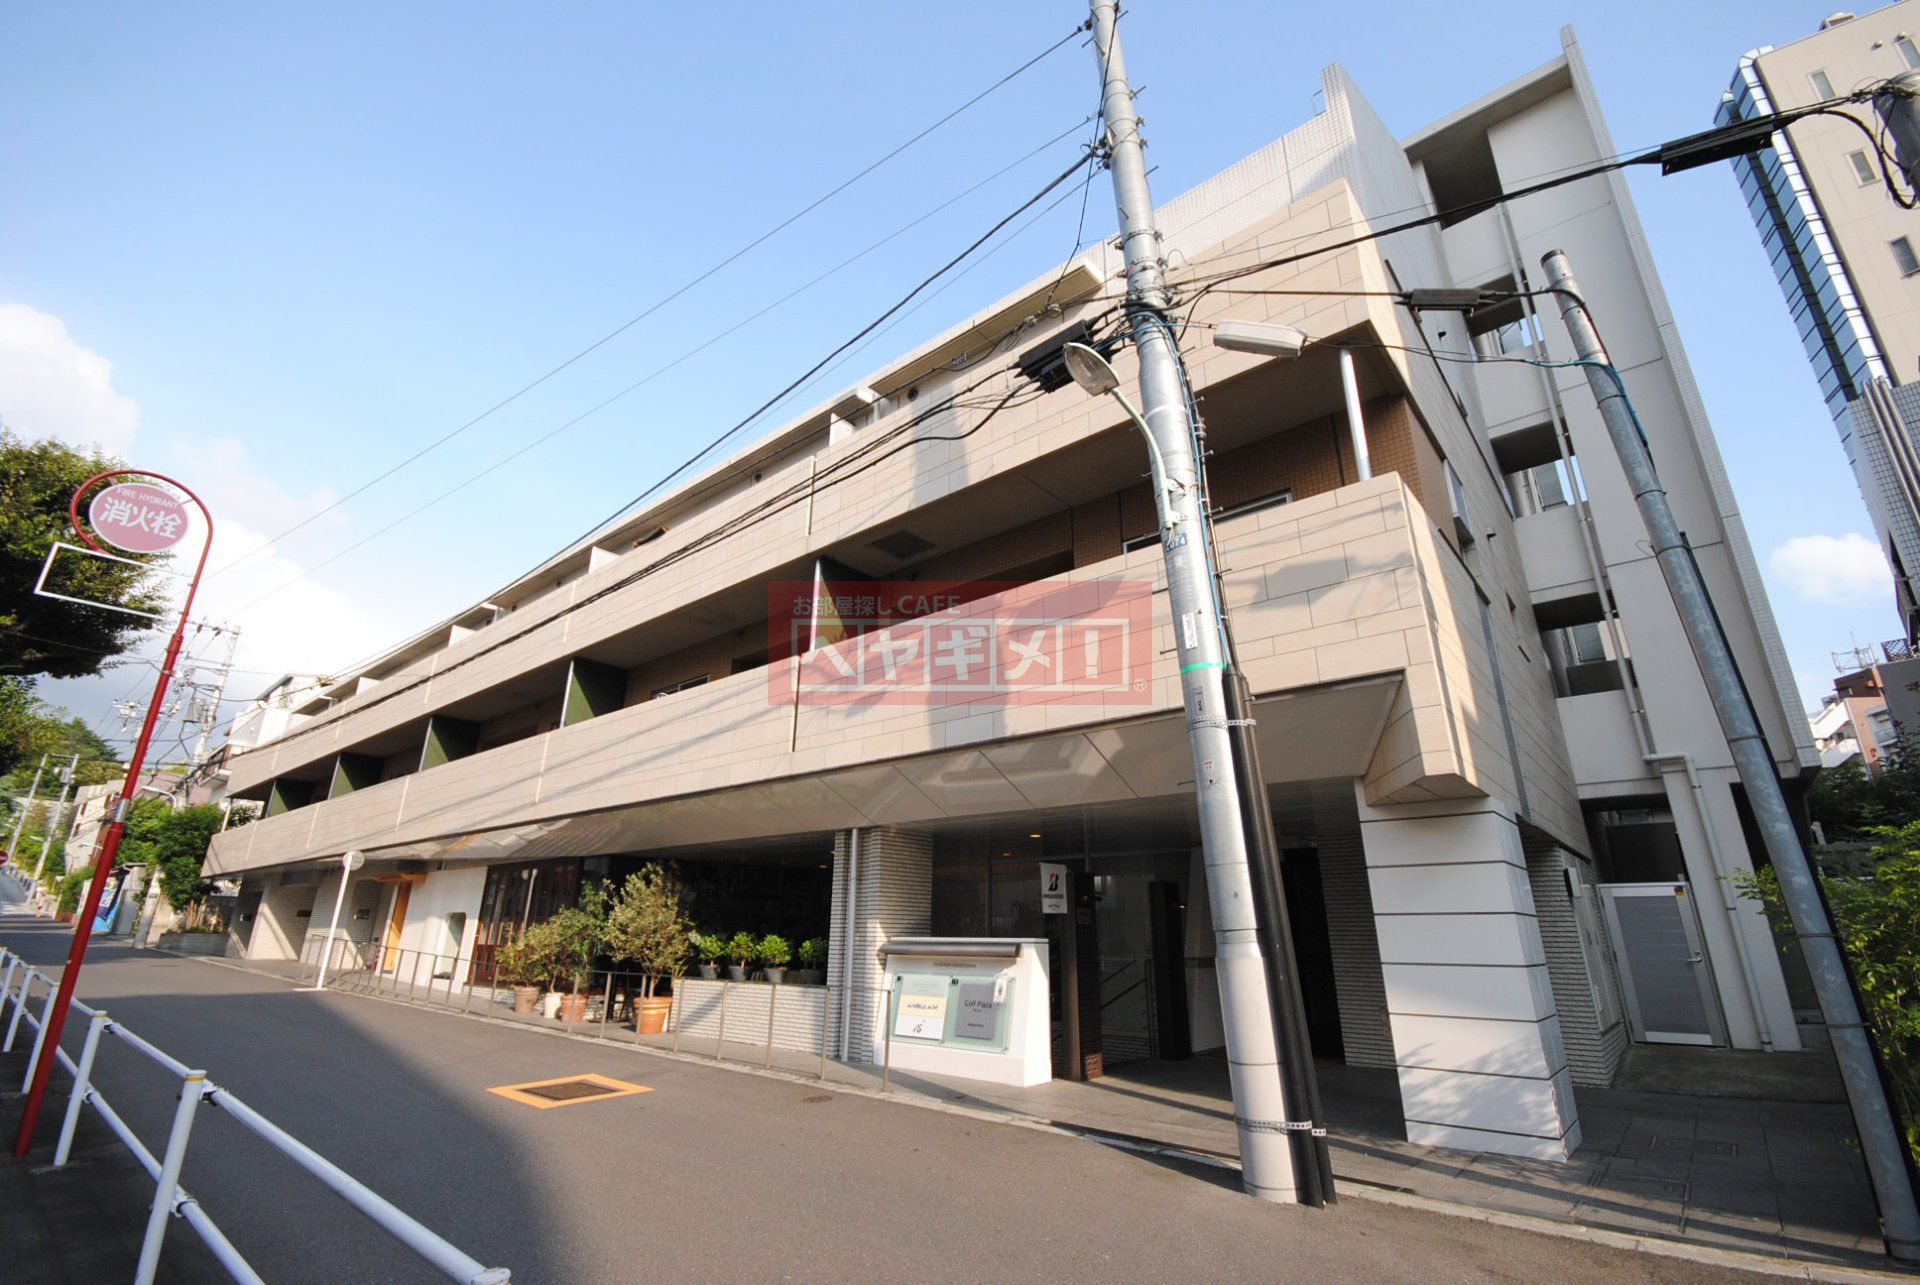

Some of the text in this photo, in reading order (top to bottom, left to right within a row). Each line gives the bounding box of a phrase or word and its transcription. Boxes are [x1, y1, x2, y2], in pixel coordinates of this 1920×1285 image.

[118, 487, 178, 508] FIRE HYDRANT
[99, 497, 182, 539] 消火栓
[964, 1000, 993, 1009] Golf Plaza
